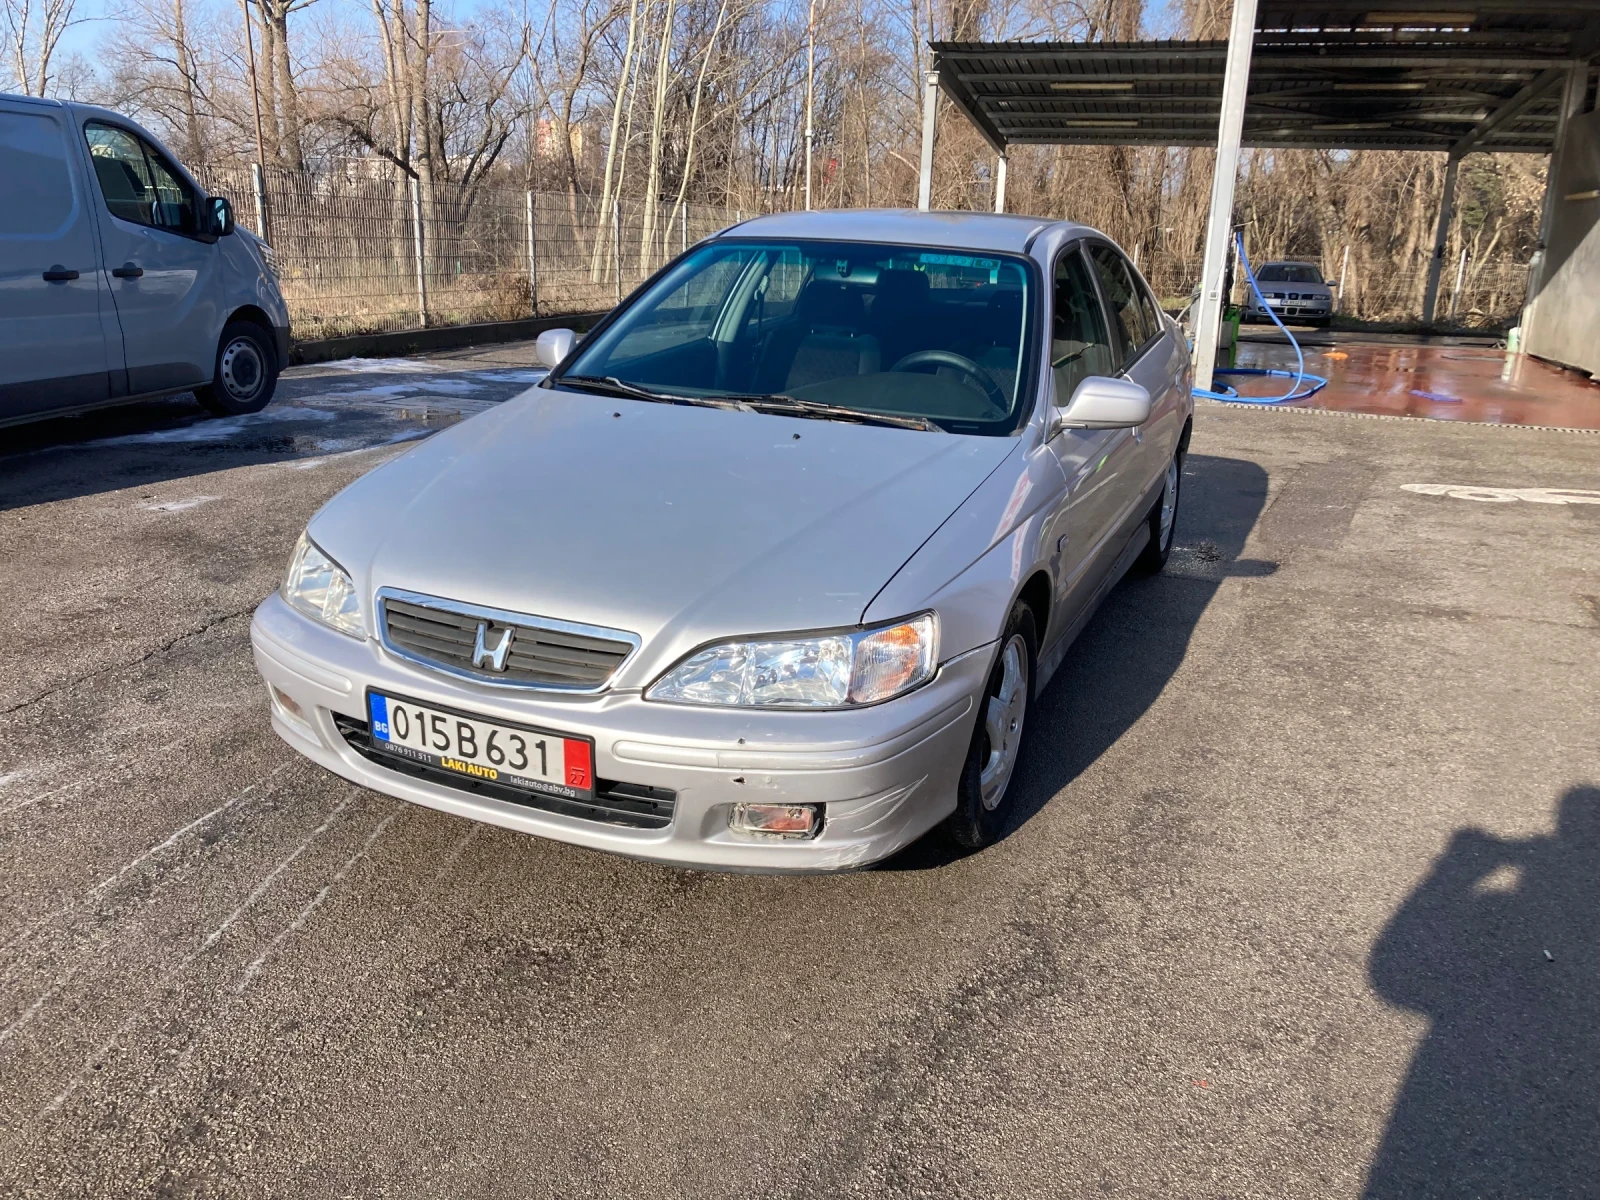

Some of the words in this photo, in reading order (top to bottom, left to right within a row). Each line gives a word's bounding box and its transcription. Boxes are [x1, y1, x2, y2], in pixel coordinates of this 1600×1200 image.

[472, 621, 515, 671] H
[374, 720, 388, 733] BG
[385, 743, 402, 753] 0876
[404, 749, 416, 757] 911
[441, 756, 466, 771] LAKI
[467, 764, 498, 780] AUTO
[510, 776, 576, 797] lakiauto@abv.bg
[571, 773, 586, 785] 27
